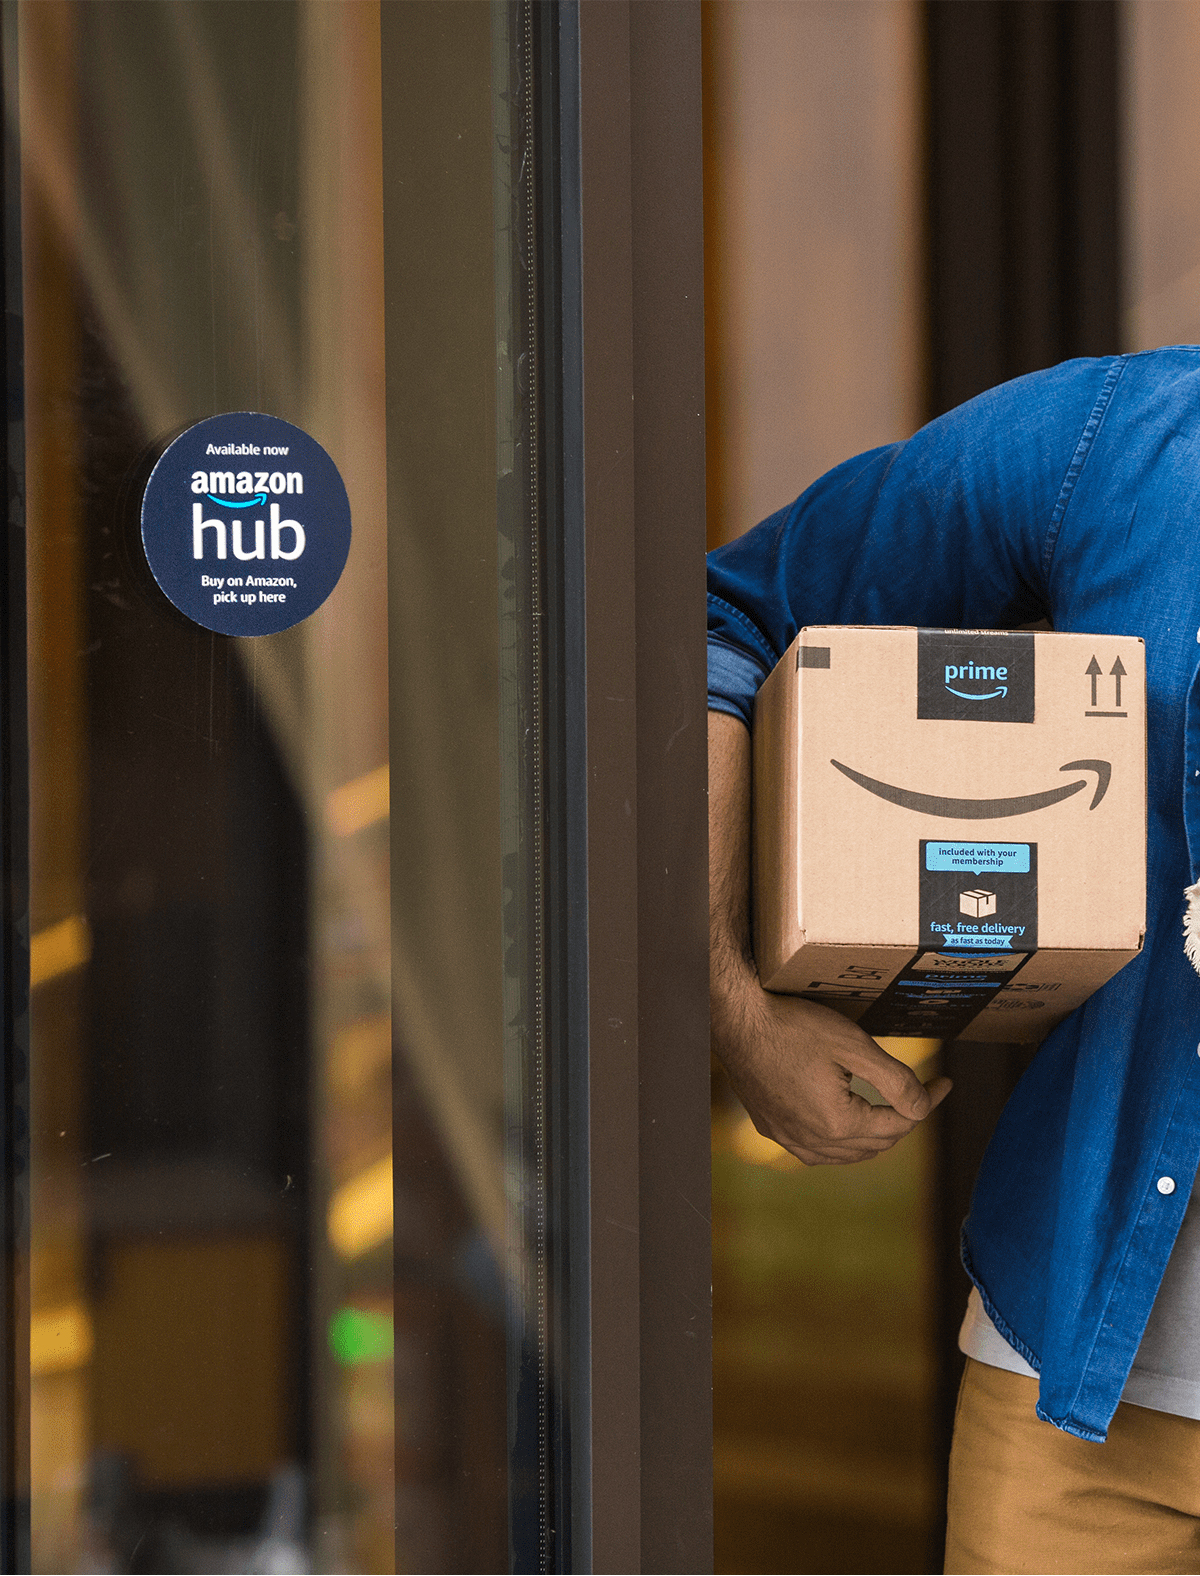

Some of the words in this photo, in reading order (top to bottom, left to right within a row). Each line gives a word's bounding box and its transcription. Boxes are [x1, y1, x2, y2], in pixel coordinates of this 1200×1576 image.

[206, 443, 261, 456] Available
[263, 446, 289, 456] now
[191, 470, 304, 494] amazon
[192, 502, 306, 561] hub
[201, 575, 225, 589] Buy
[227, 577, 243, 587] on
[245, 575, 298, 588] Amazon,
[213, 590, 238, 605] pick
[240, 593, 257, 605] up
[259, 590, 287, 603] here
[944, 660, 1008, 684] prime
[938, 847, 975, 856] included
[976, 848, 996, 857] with
[997, 850, 1018, 859] your
[951, 857, 1004, 867] membership
[930, 921, 954, 934] fast,
[956, 921, 979, 933] free
[981, 922, 1026, 937] delivery
[960, 936, 974, 945] fast
[974, 937, 983, 945] as
[984, 937, 1006, 946] today
